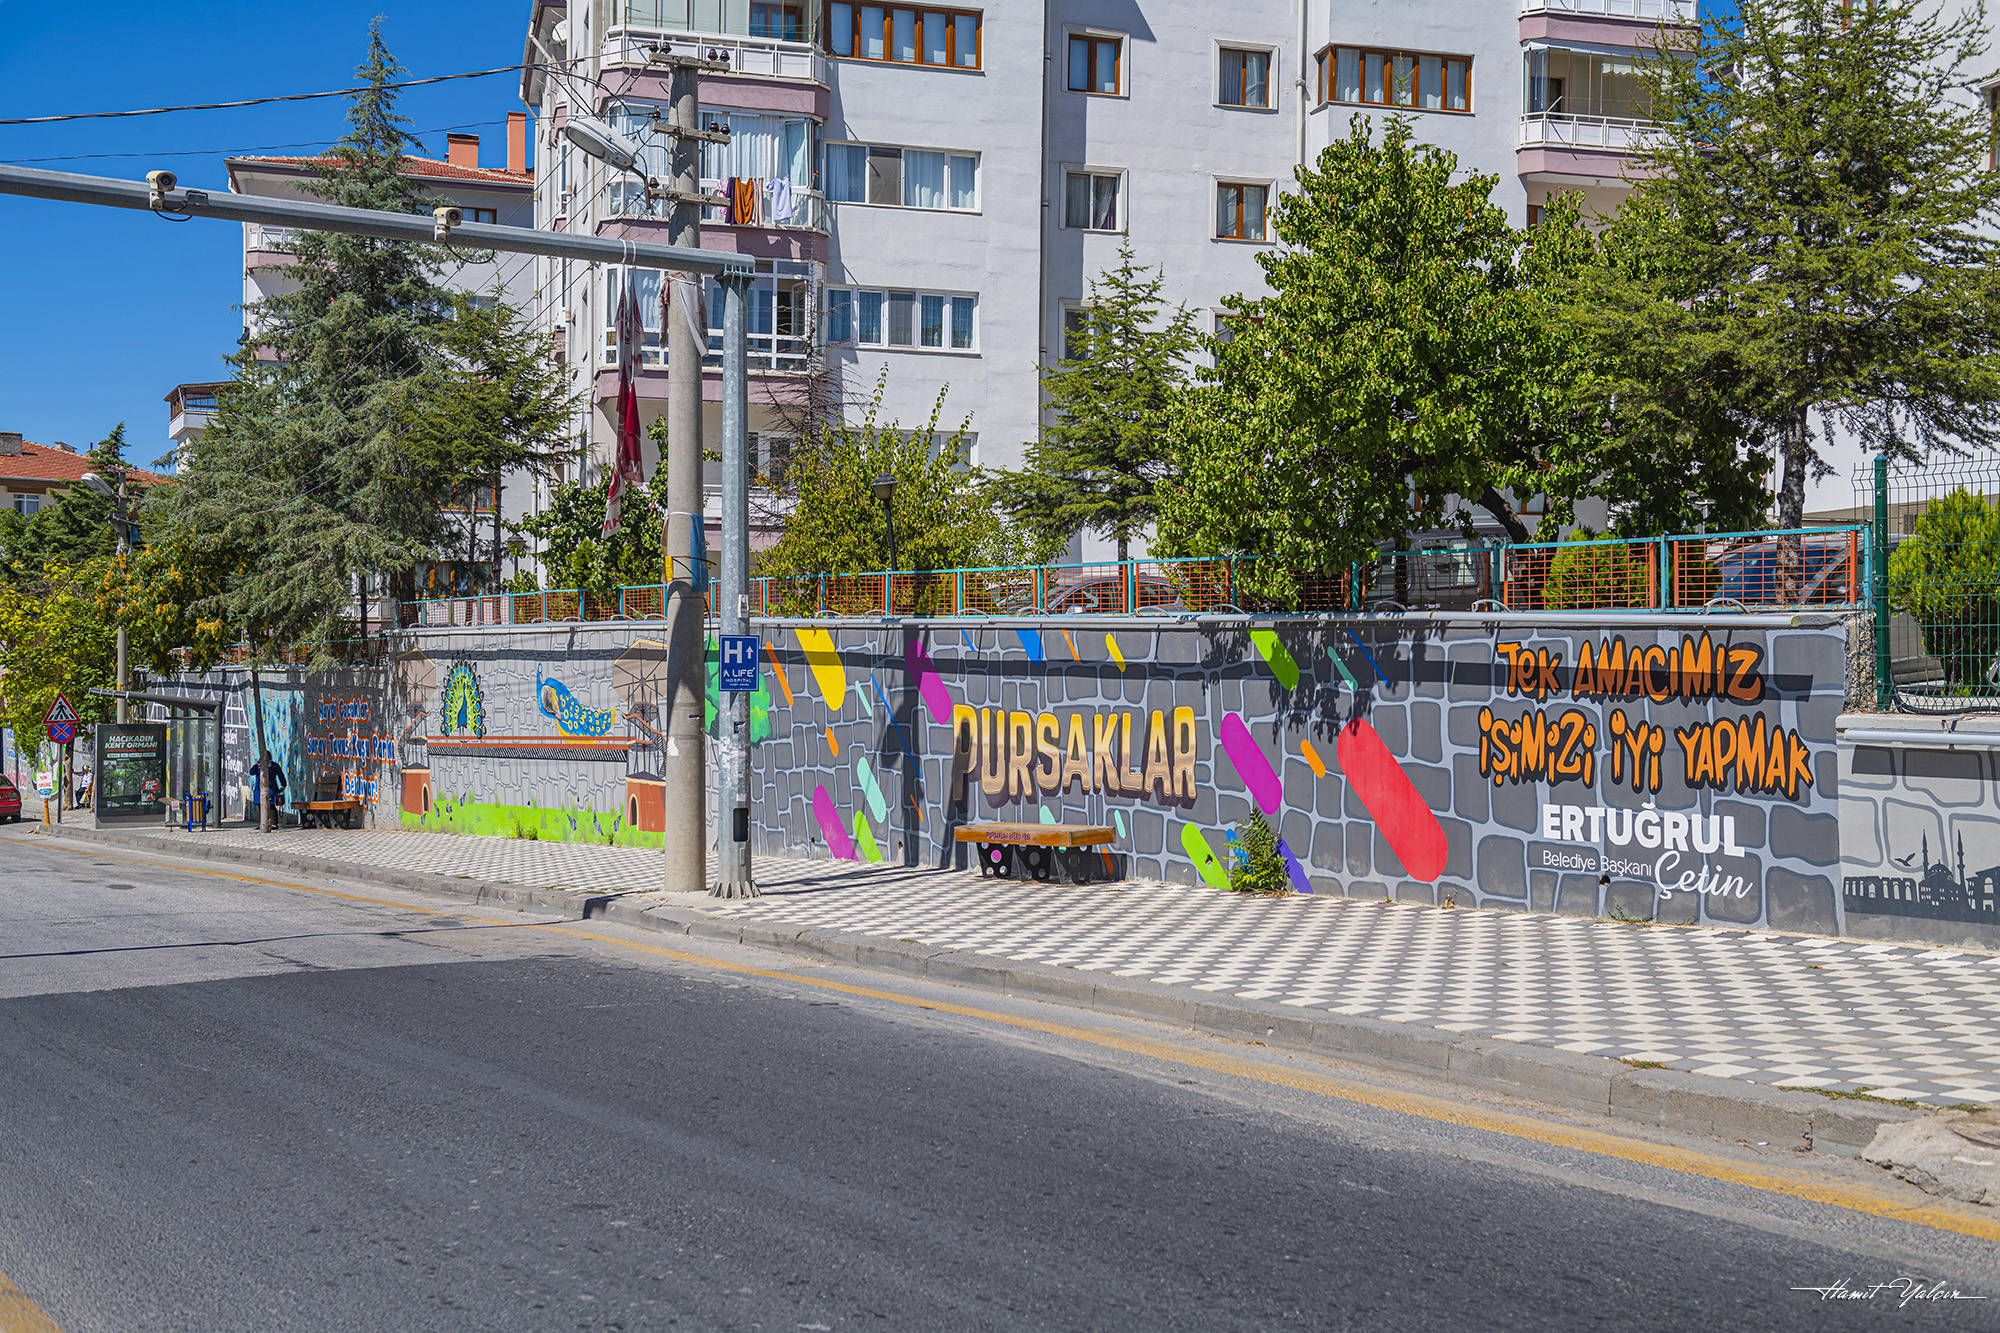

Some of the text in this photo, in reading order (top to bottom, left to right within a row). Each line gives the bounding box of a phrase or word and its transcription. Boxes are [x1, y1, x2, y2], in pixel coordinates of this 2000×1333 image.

[725, 641, 743, 663] H
[732, 669, 754, 677] LIFE
[1497, 642, 1562, 701] Tek
[318, 698, 337, 729] Haydi
[307, 732, 396, 768] Saray Tavus Kuşu Parkı
[953, 704, 1198, 802] PURSAKLAR
[1677, 712, 1814, 799] YAPMAK
[344, 772, 379, 809] Bekliyor!
[986, 831, 1008, 840] PURSAKLAR
[1543, 803, 1745, 857] ERTUĞRUL
[1542, 850, 1753, 900] Belediye Başkanı Çetin
